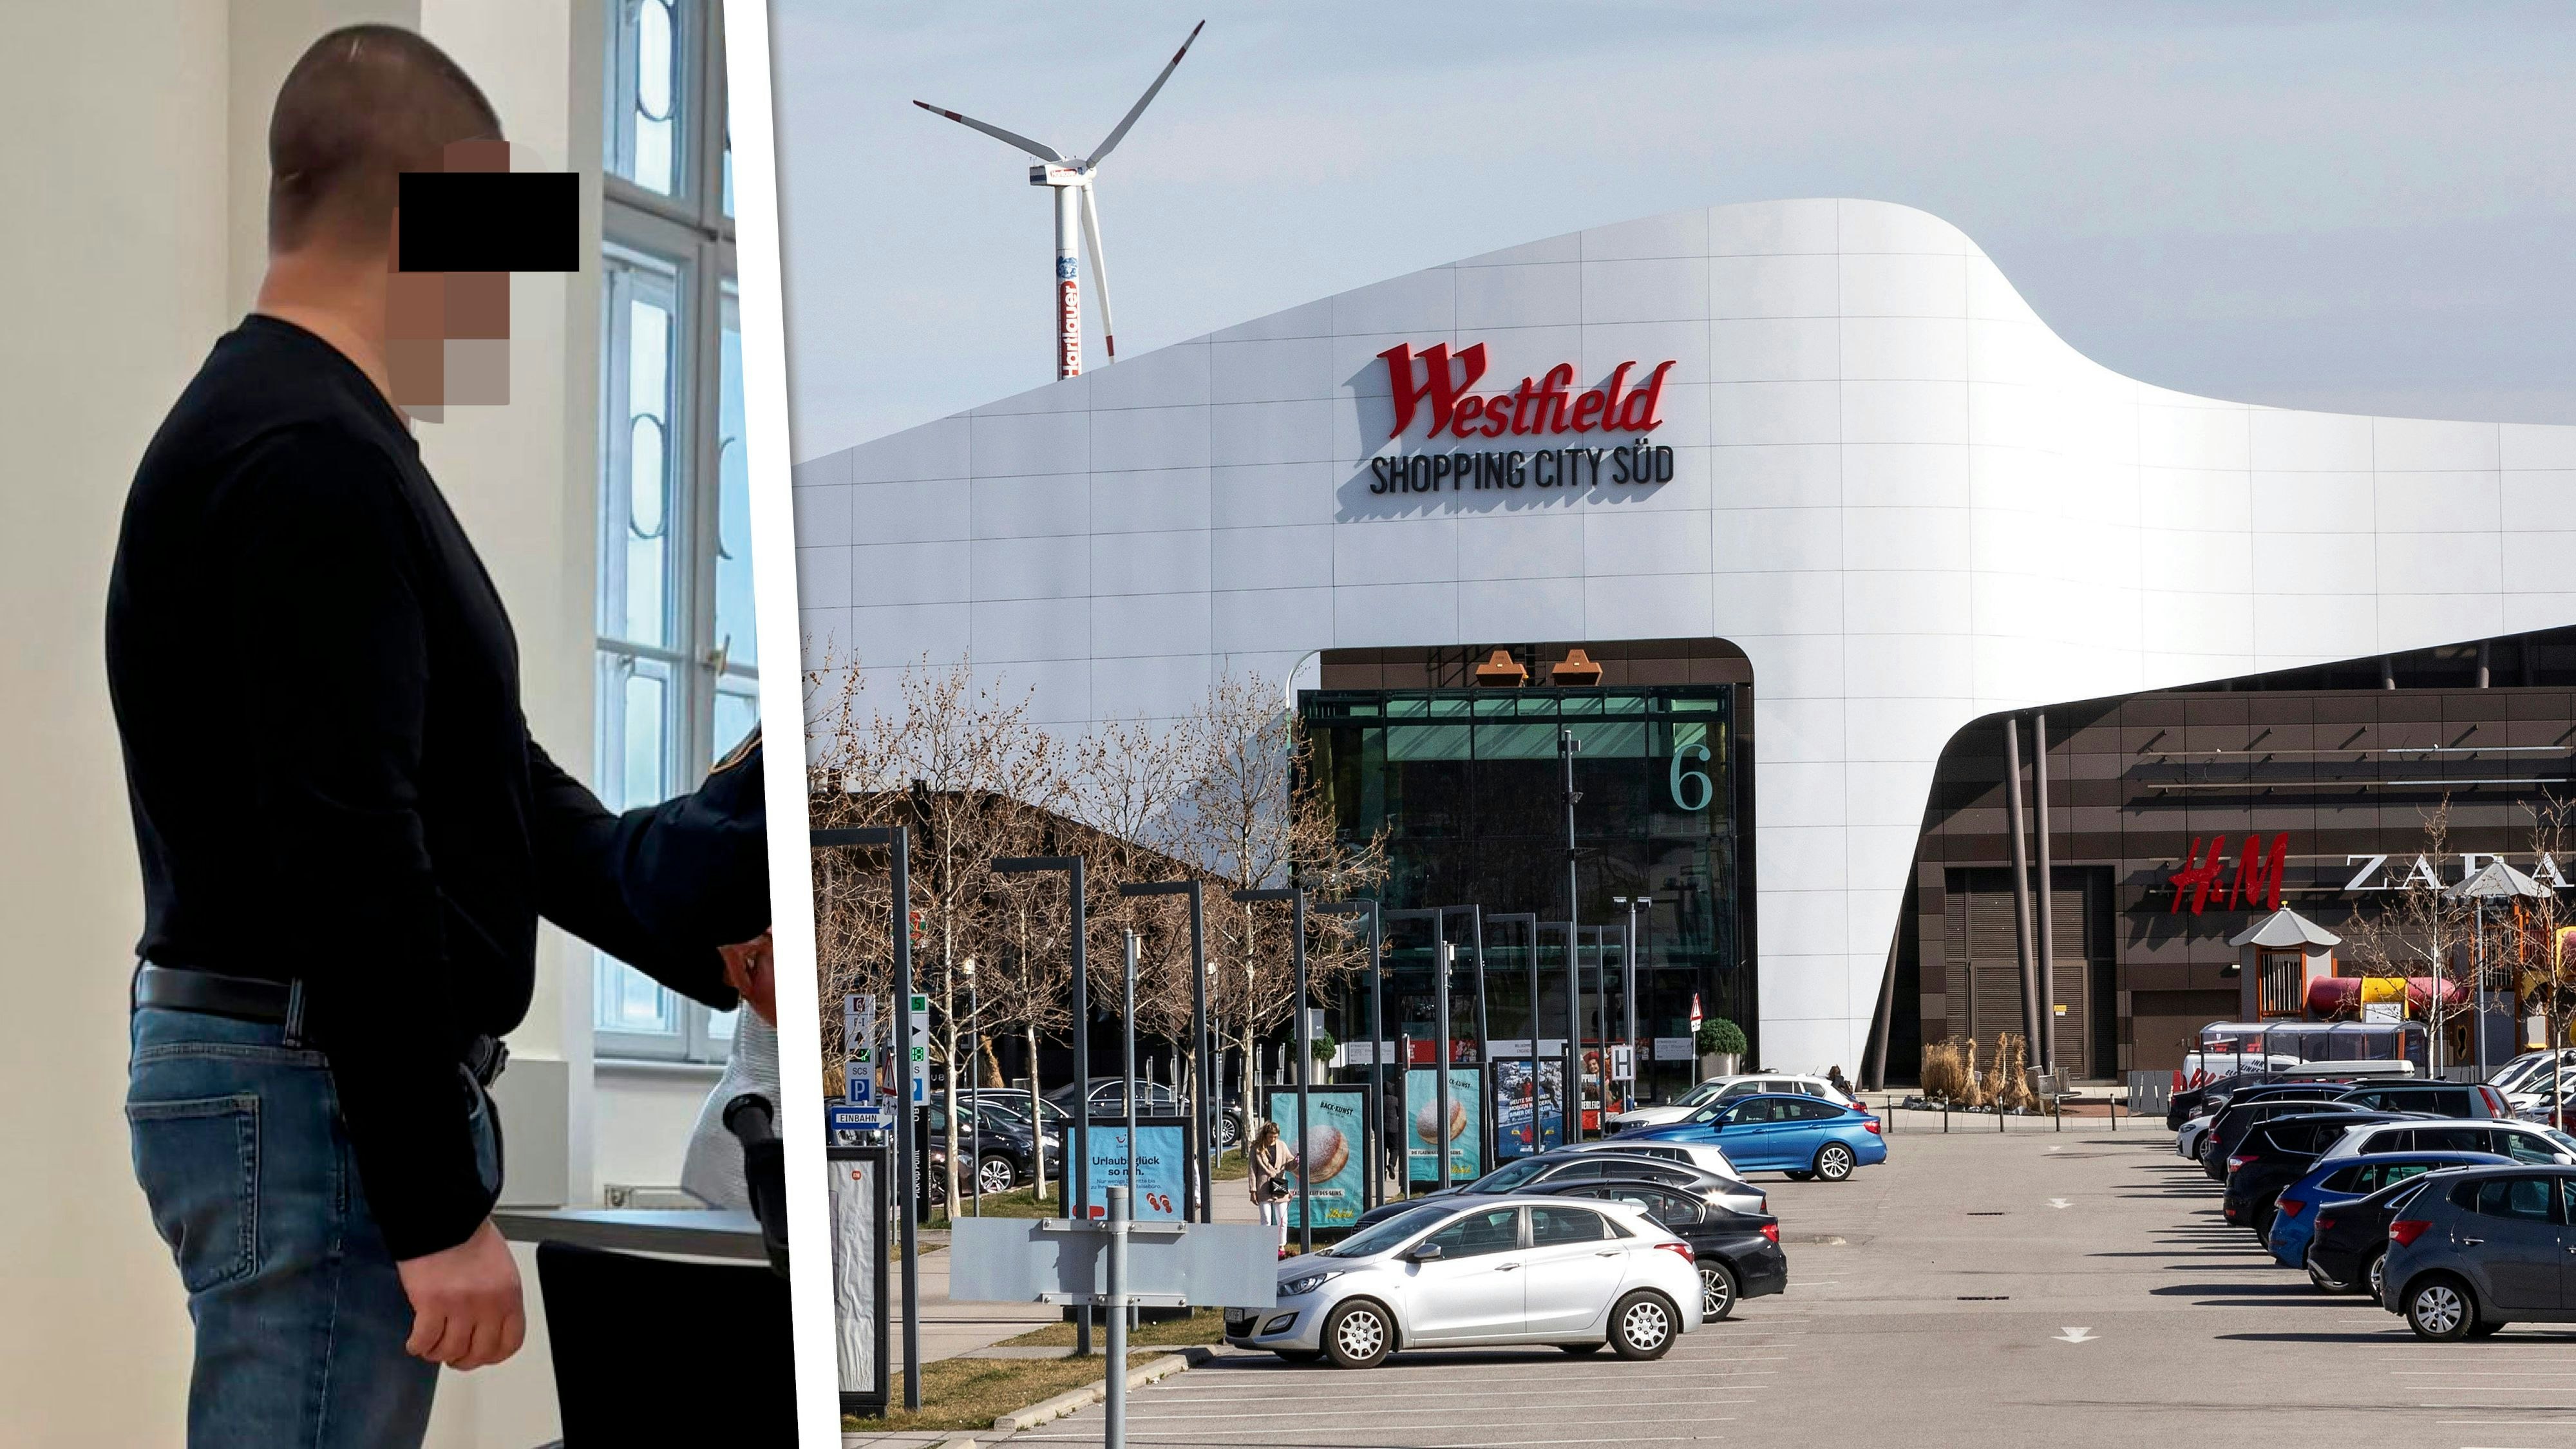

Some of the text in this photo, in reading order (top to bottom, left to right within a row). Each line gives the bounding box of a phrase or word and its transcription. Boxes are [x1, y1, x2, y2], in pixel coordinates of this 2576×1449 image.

[1063, 285, 1079, 378] Hartlauer
[1377, 342, 1677, 439] Westfield
[1369, 438, 1674, 495] SHOPPING CITY SÜD
[1670, 743, 1714, 811] 6
[2168, 832, 2289, 916] H&M
[856, 998, 863, 1011] 6
[914, 999, 921, 1010] 5
[1615, 1049, 1632, 1077] H
[855, 1080, 866, 1101] P
[1092, 1156, 1160, 1167] Urlaubglück
[1122, 1168, 1144, 1176] nh.
